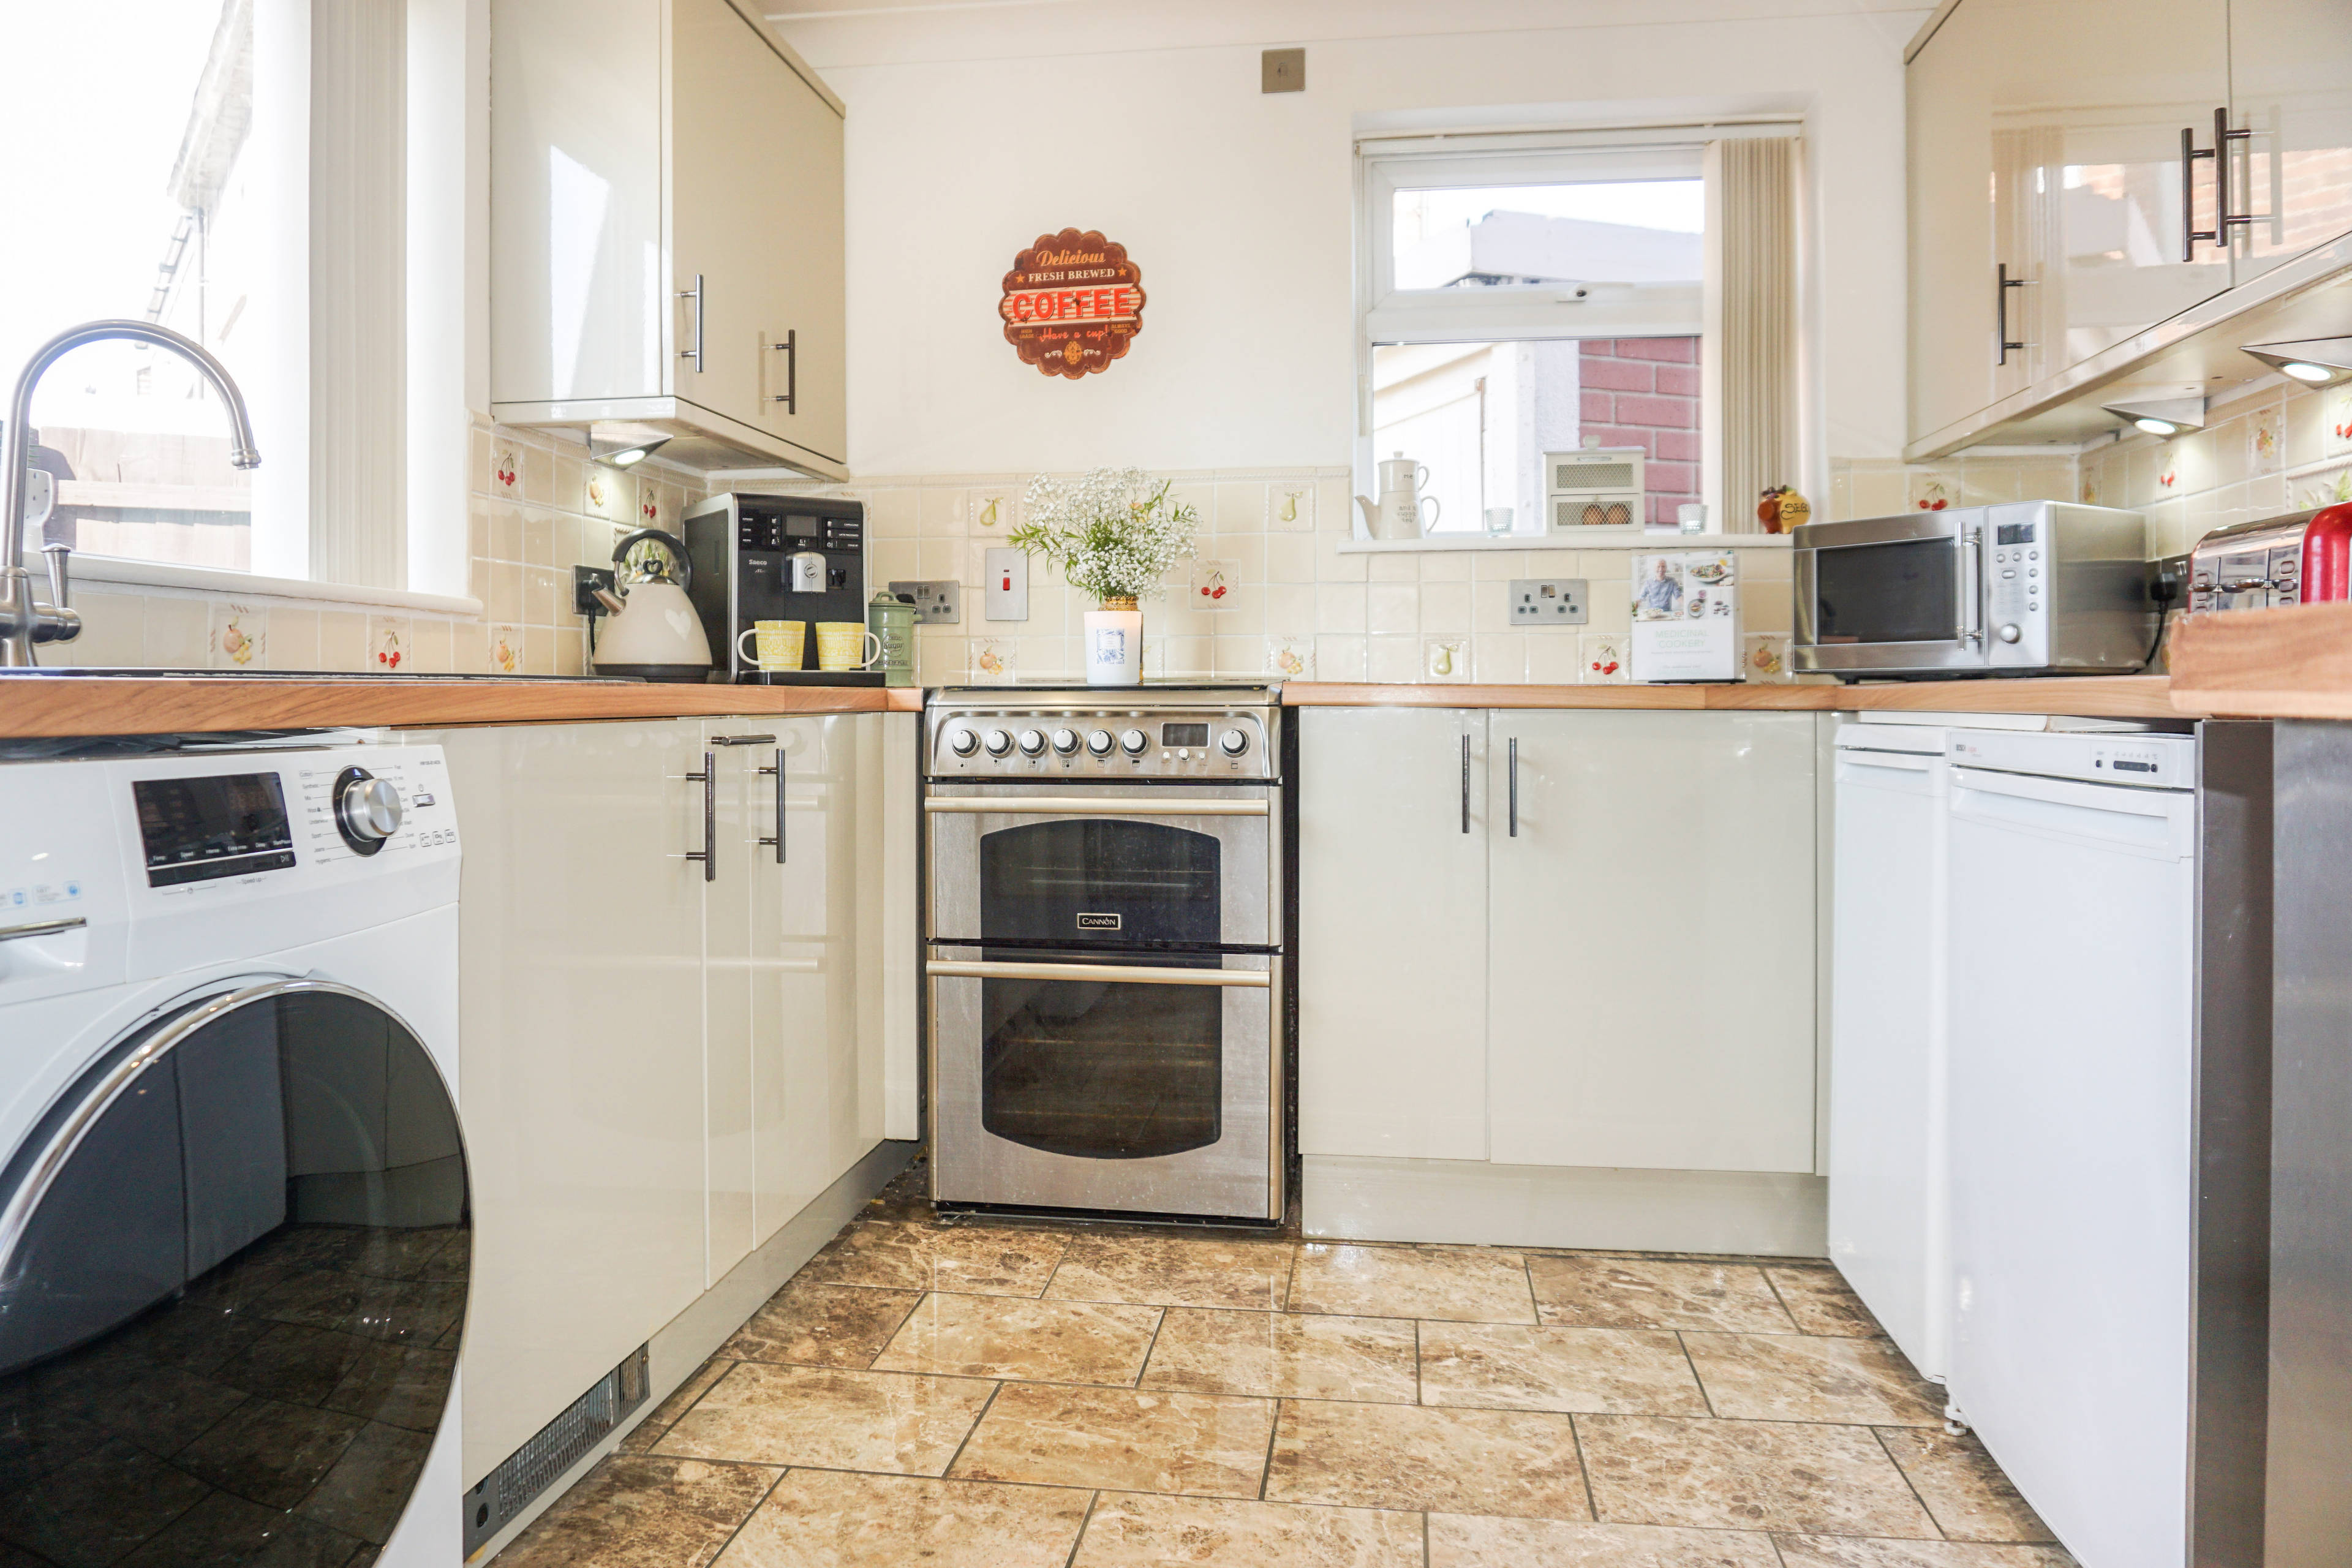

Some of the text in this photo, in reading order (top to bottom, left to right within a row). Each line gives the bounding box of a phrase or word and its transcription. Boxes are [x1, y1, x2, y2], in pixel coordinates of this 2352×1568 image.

[1036, 249, 1106, 266] Delicious
[1028, 268, 1115, 282] FRESH BREWED
[1012, 287, 1131, 319] COFFEE
[1039, 328, 1069, 342] Have
[1087, 325, 1108, 341] cup!
[1656, 629, 1710, 638] MEDICINAL
[1659, 639, 1705, 648] COOKERY
